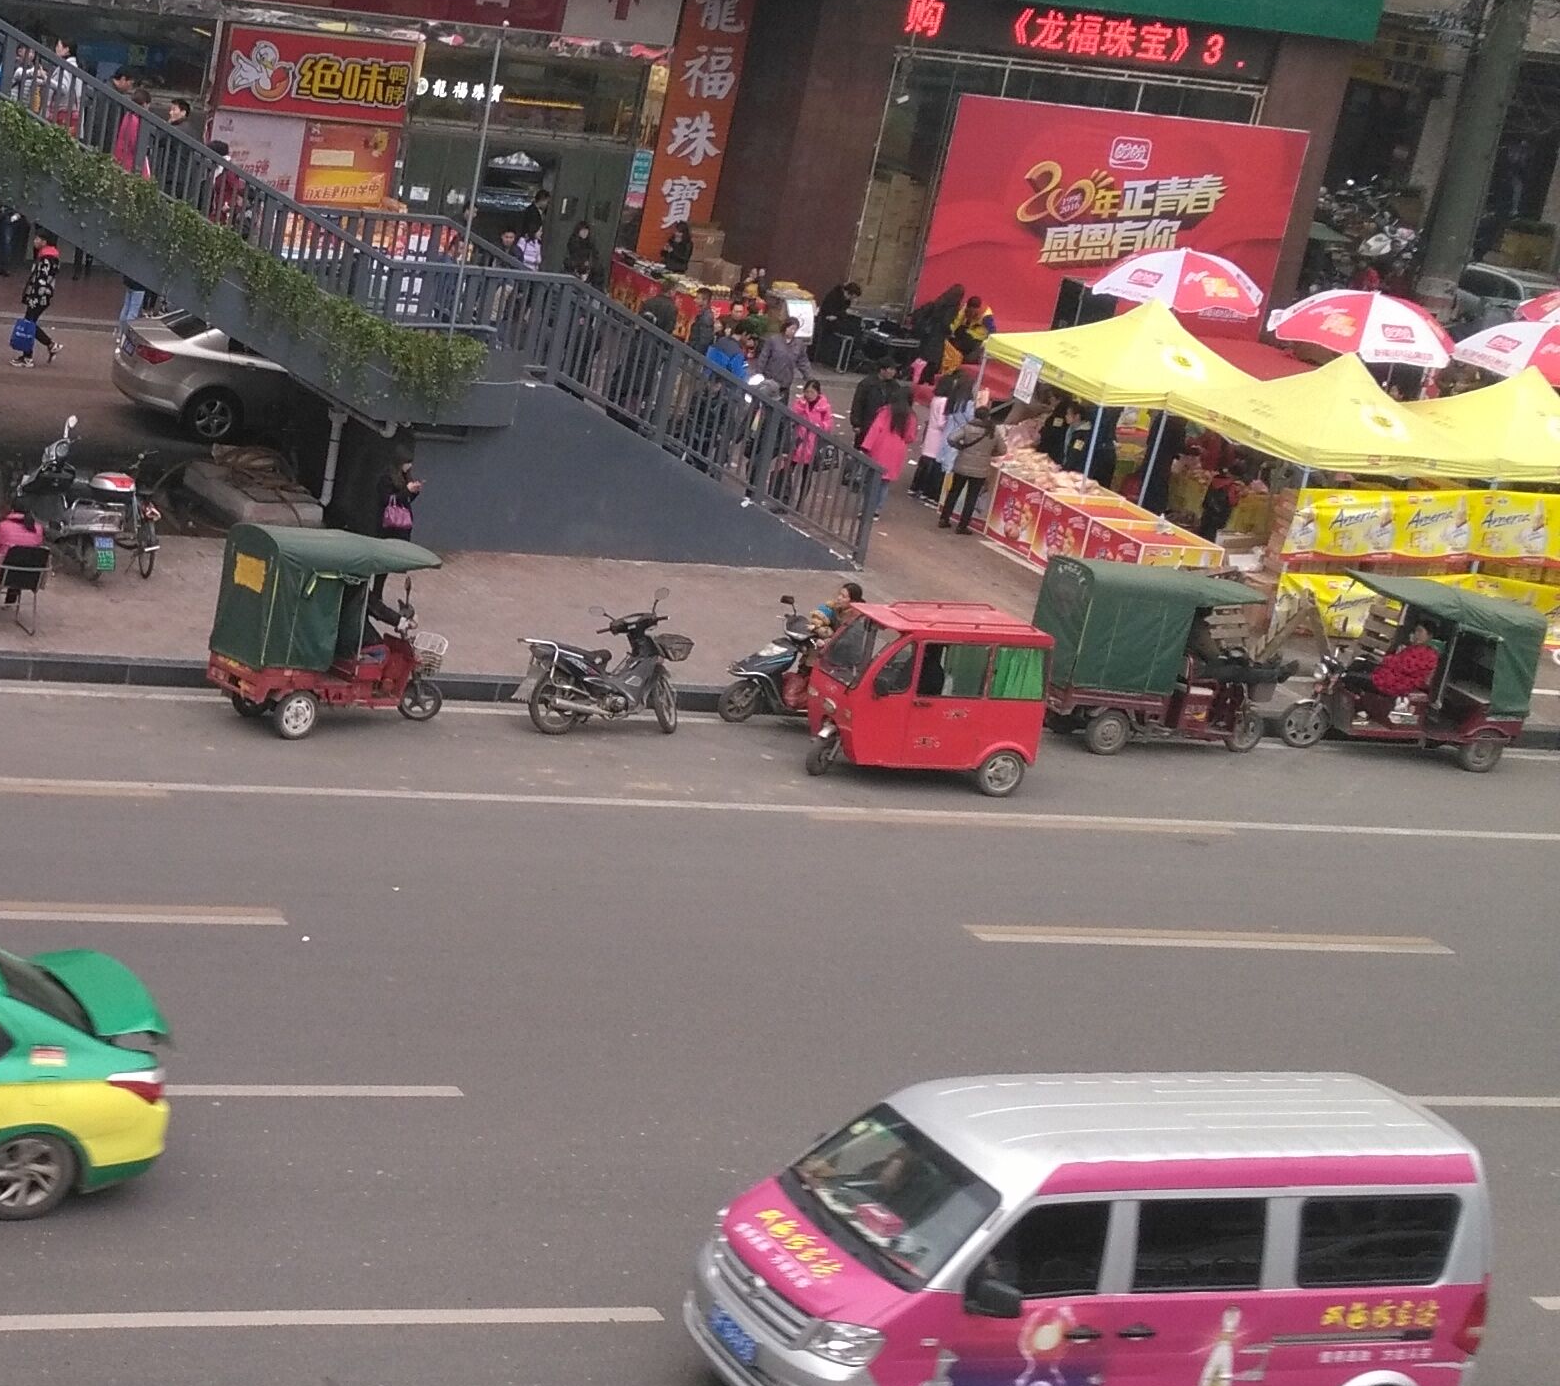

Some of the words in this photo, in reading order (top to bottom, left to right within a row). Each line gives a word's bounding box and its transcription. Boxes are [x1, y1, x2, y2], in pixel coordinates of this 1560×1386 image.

[296, 54, 388, 103] 绝味
[1016, 160, 1229, 223] 20年正青春
[1037, 218, 1182, 265] 感恩有你
